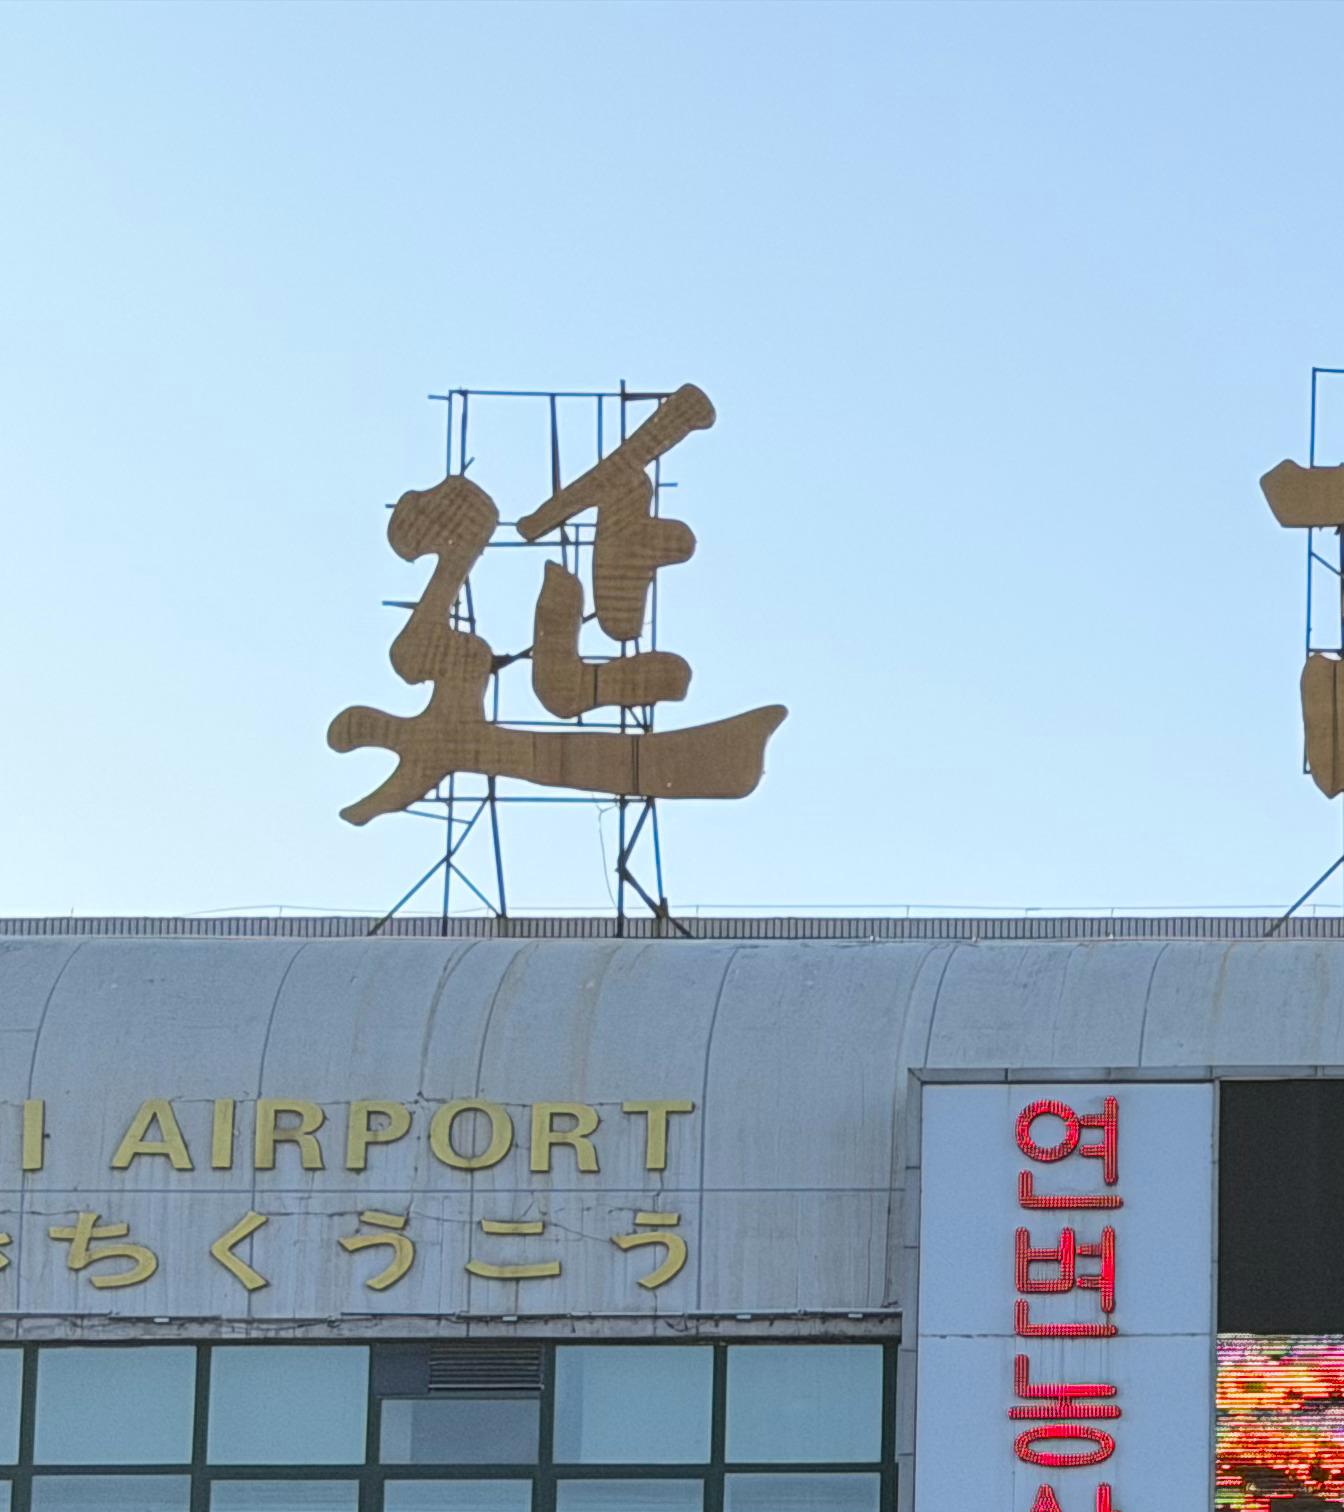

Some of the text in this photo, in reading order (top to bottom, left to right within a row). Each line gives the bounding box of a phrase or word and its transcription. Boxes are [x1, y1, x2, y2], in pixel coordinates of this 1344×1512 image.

[110, 1098, 694, 1173] AIRPORT
[0, 1211, 688, 1290] ちくうこう
